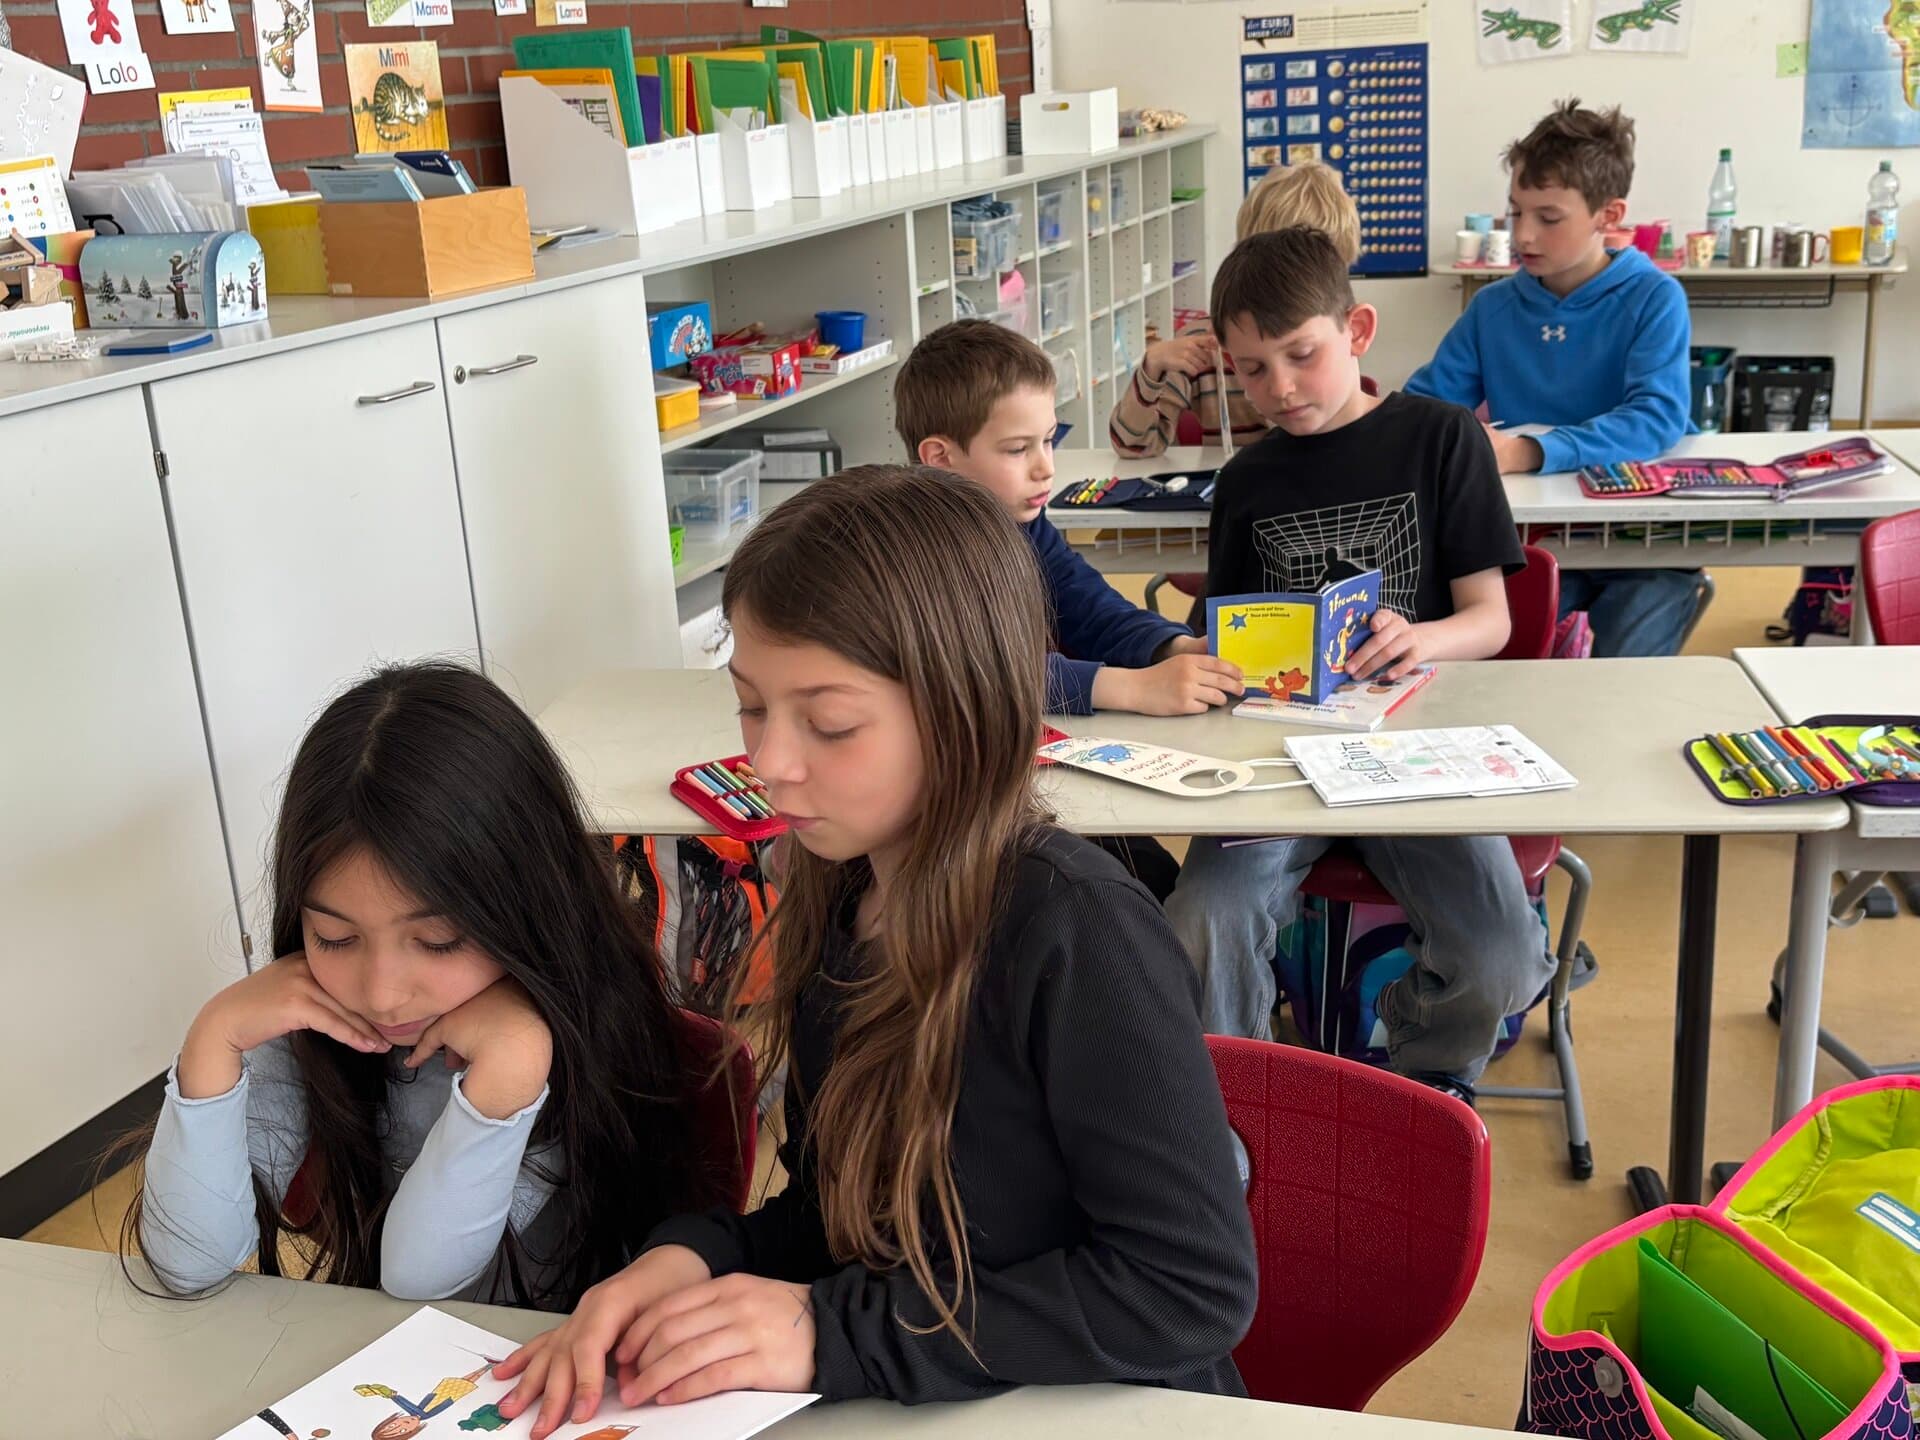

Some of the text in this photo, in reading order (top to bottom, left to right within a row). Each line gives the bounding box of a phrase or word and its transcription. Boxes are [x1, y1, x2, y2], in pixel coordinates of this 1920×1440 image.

[416, 1, 449, 17] Mama
[559, 4, 584, 19] Lama
[1261, 17, 1290, 29] EURO
[379, 47, 410, 68] Mimi
[96, 61, 138, 85] Lolo
